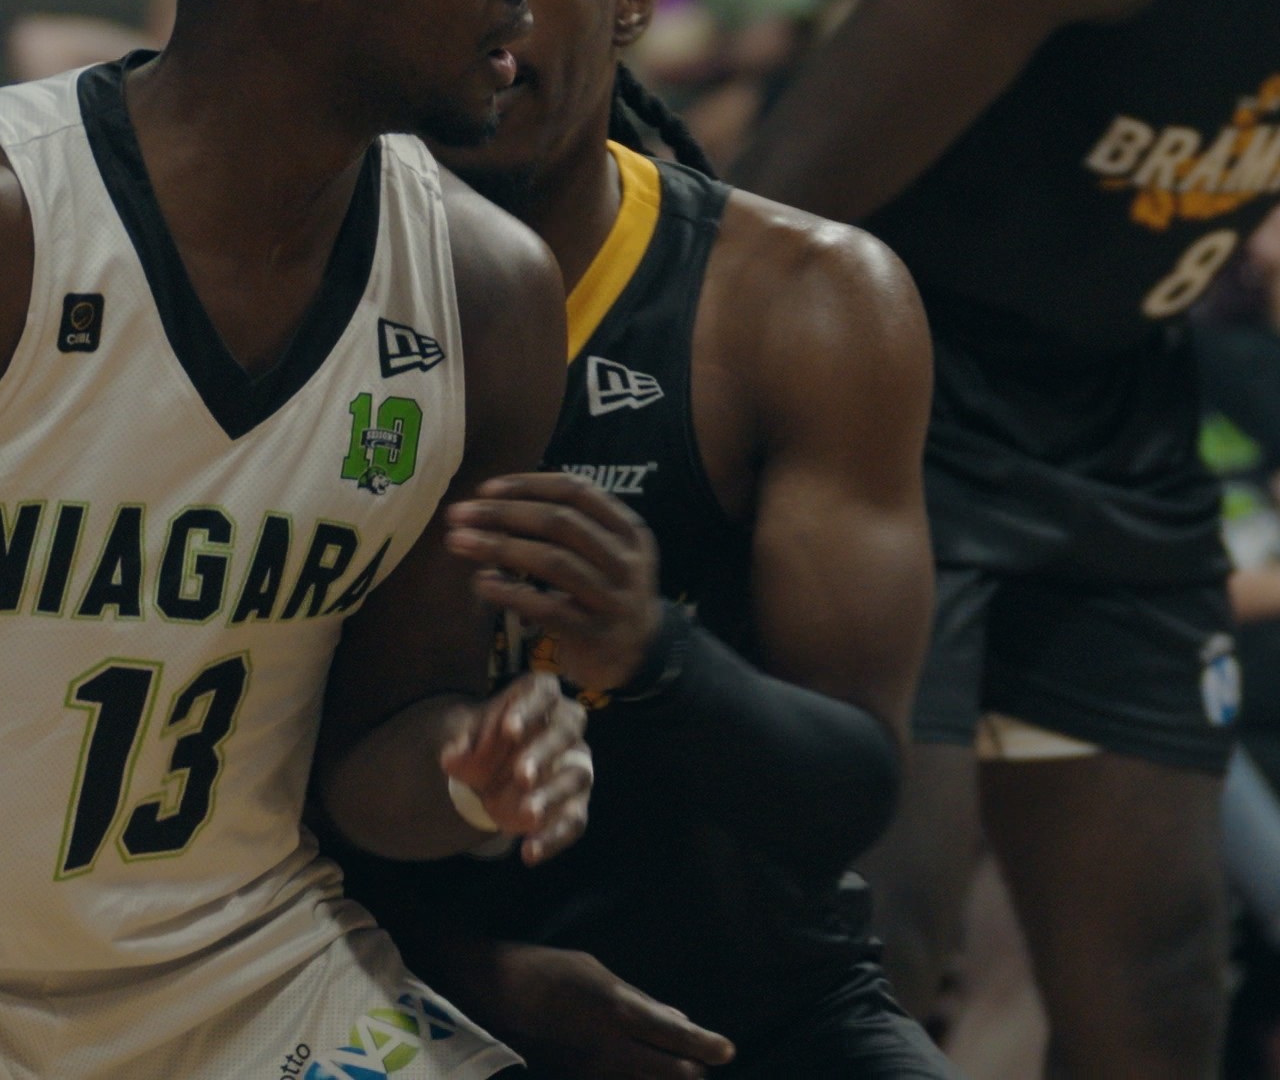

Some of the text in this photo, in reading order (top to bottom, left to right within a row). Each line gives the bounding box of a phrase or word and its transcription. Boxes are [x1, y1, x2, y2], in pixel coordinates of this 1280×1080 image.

[1140, 229, 1239, 319] 8
[341, 392, 423, 479] 10
[54, 650, 250, 881] 13
